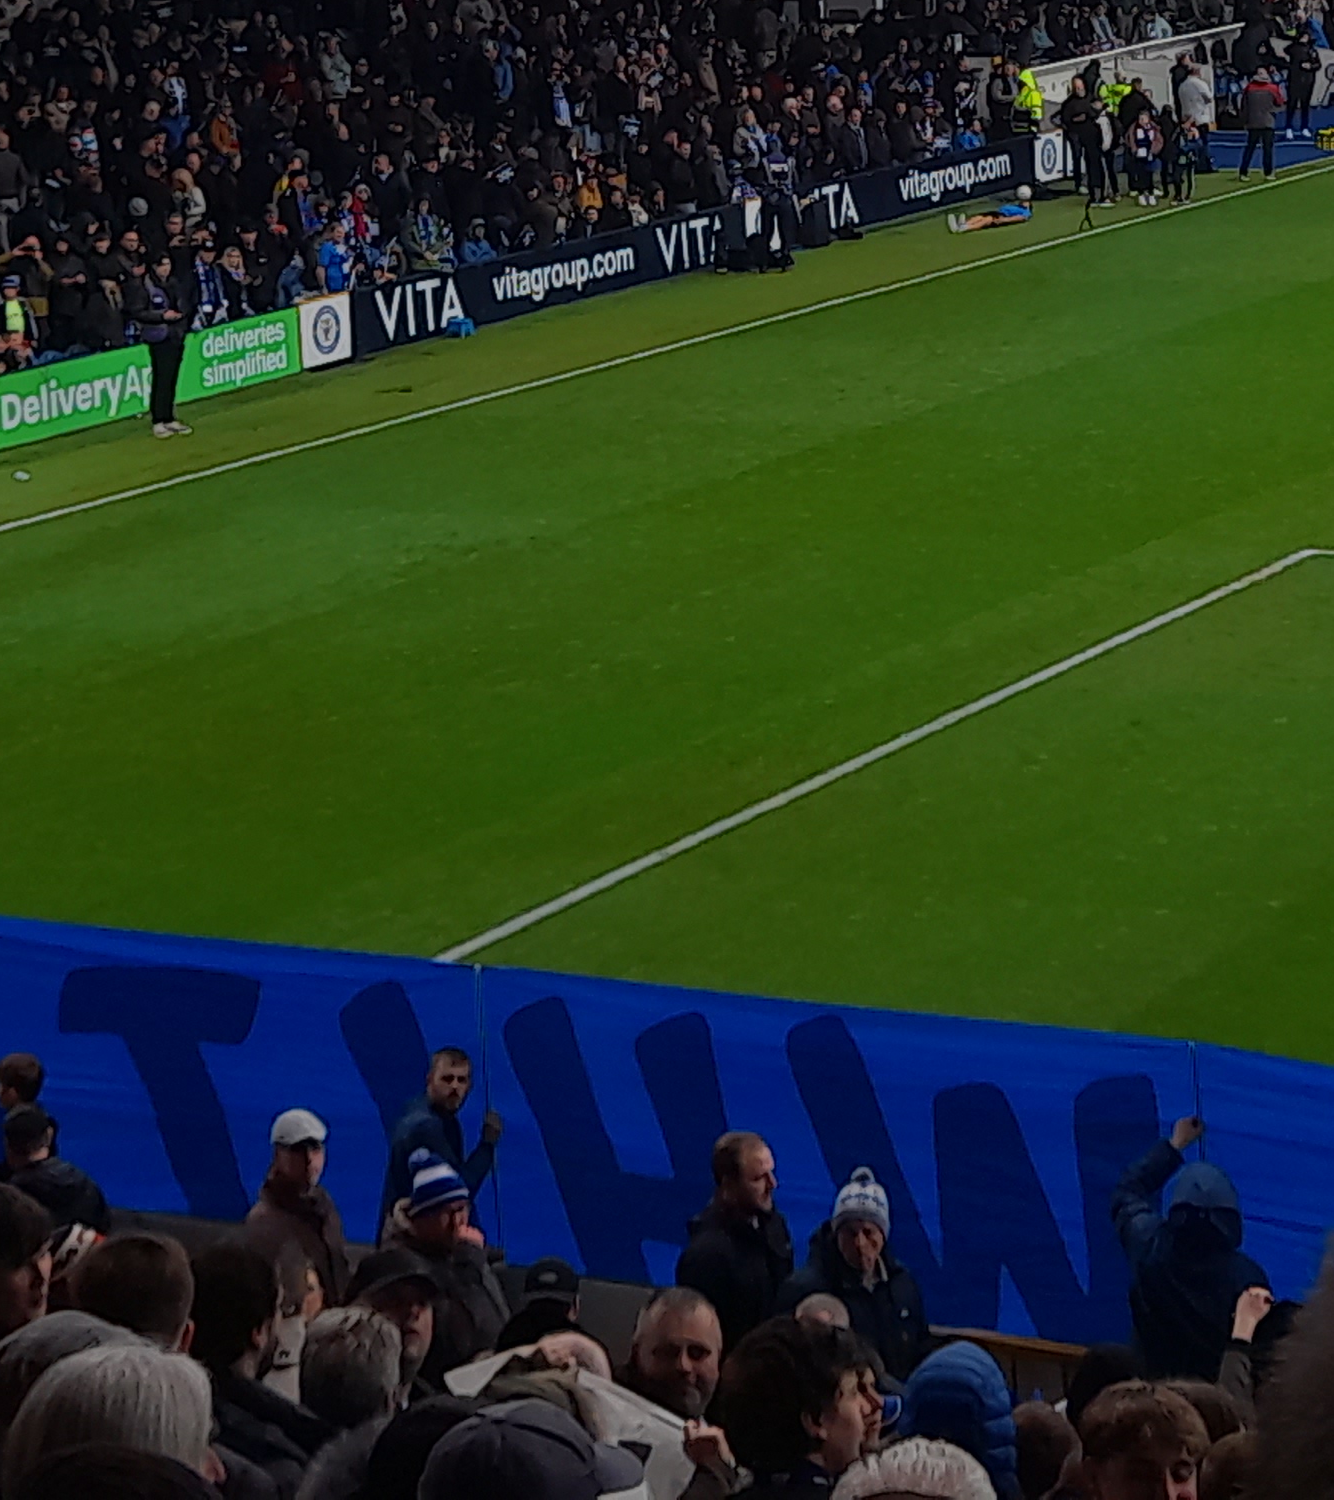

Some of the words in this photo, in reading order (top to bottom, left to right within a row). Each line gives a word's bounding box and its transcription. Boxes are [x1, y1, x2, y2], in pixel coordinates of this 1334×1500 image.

[898, 153, 1012, 203] vitagroup.com
[491, 247, 636, 301] vitagroup.com
[374, 276, 466, 342] VITA
[202, 320, 287, 358] deliveries
[202, 343, 288, 388] simplified
